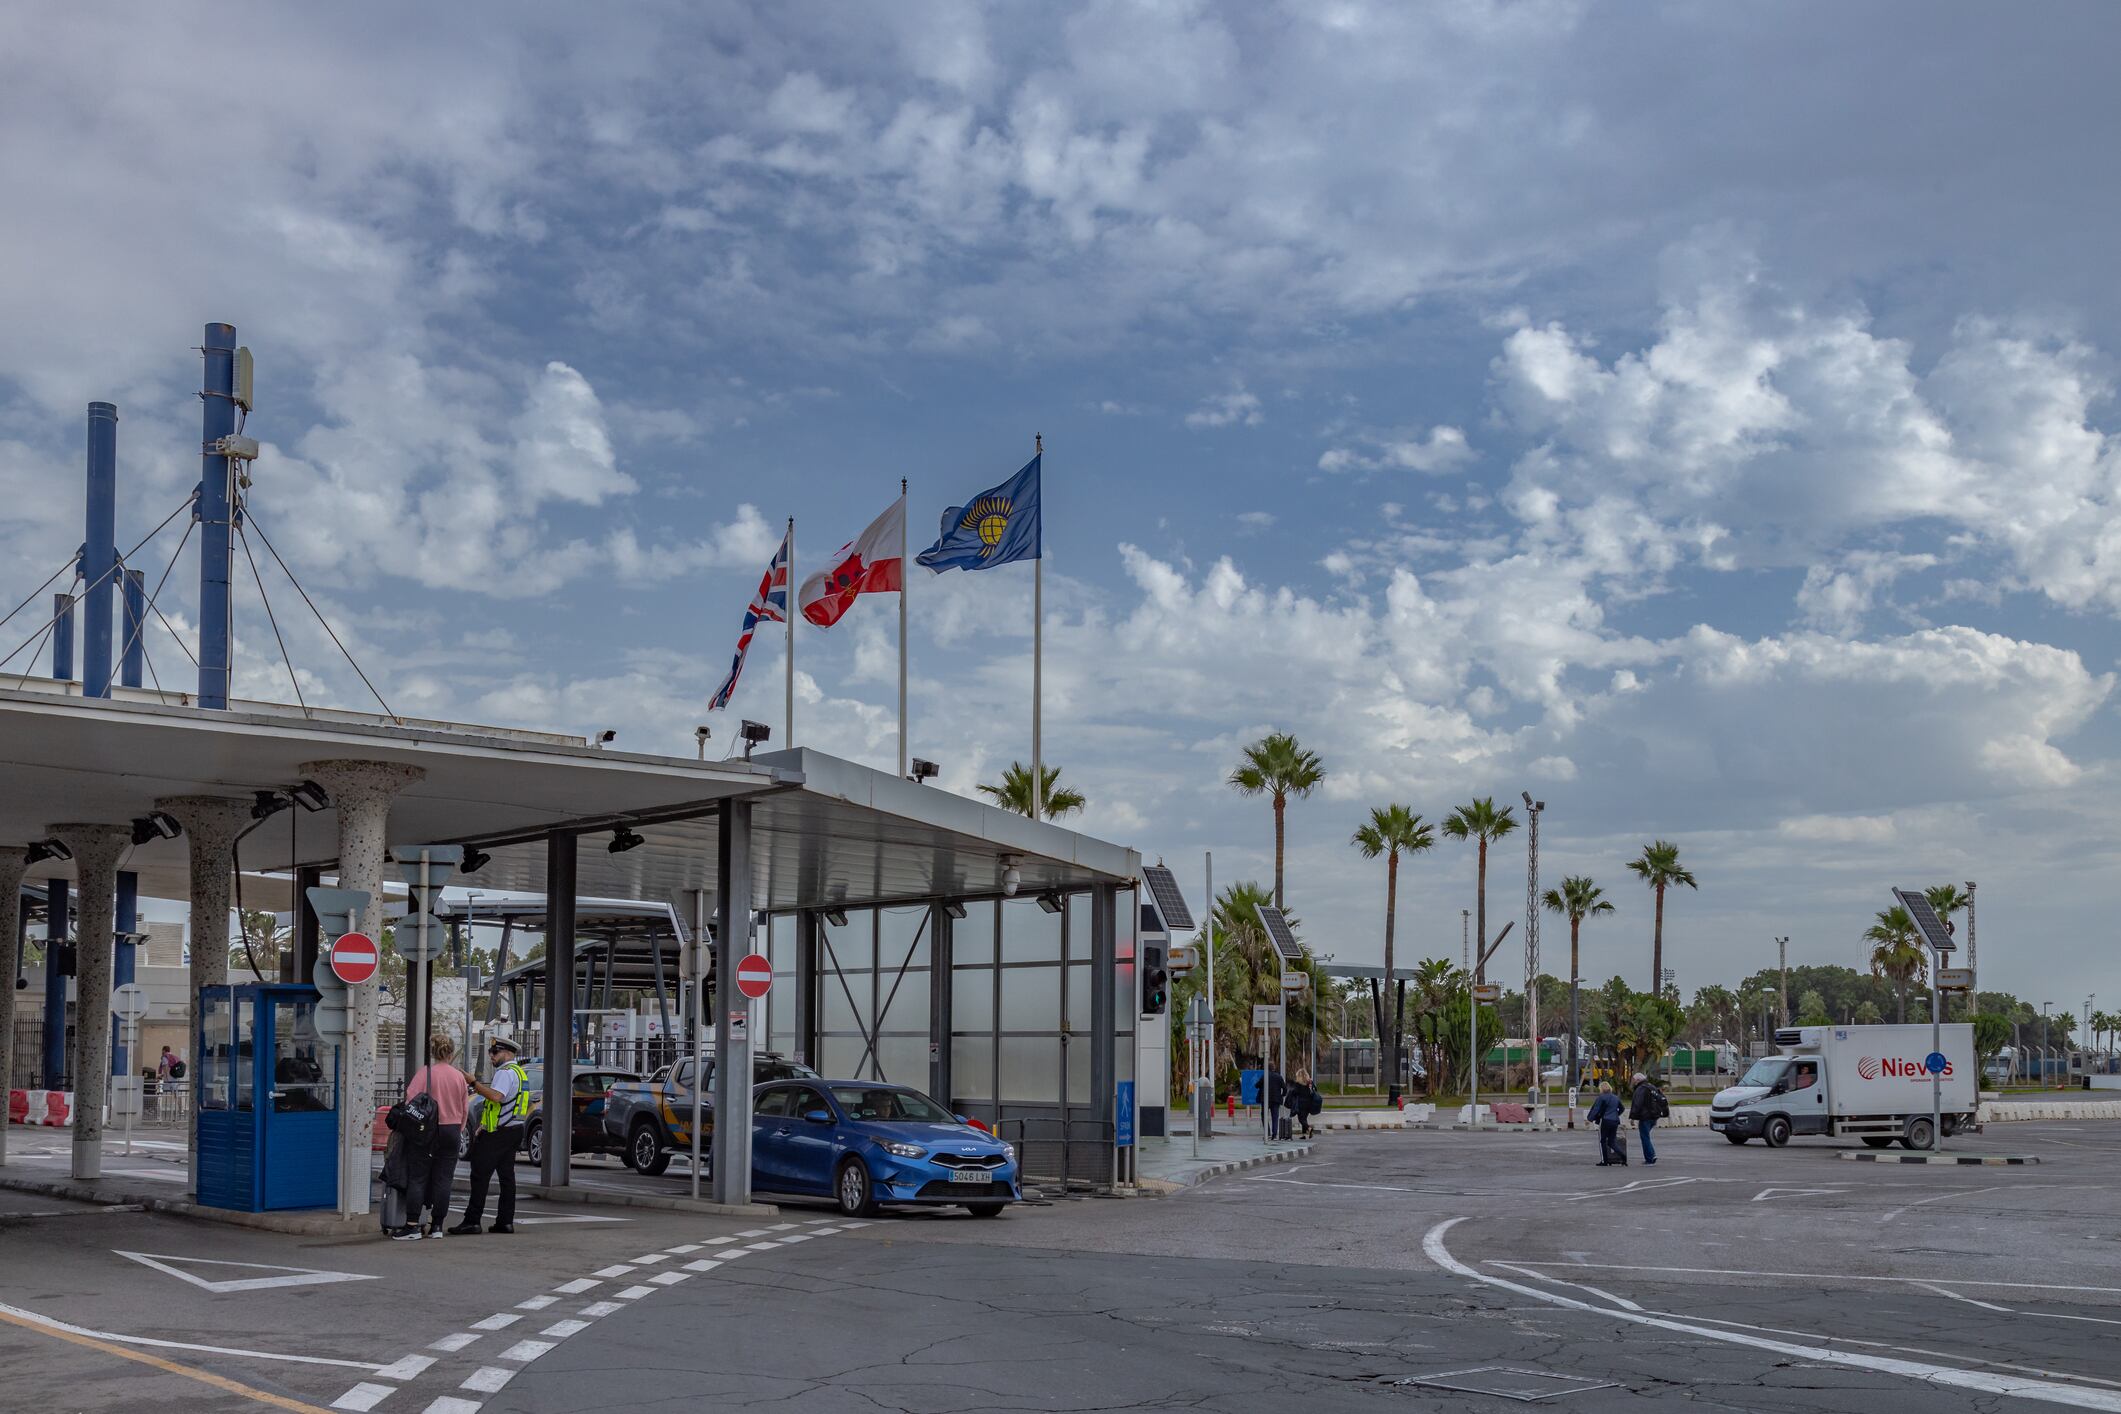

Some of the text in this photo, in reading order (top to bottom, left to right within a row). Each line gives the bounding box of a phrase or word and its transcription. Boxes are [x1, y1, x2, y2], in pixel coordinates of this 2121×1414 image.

[1881, 1058, 1953, 1077] Nievs
[954, 1171, 991, 1181] 5046 LXH
